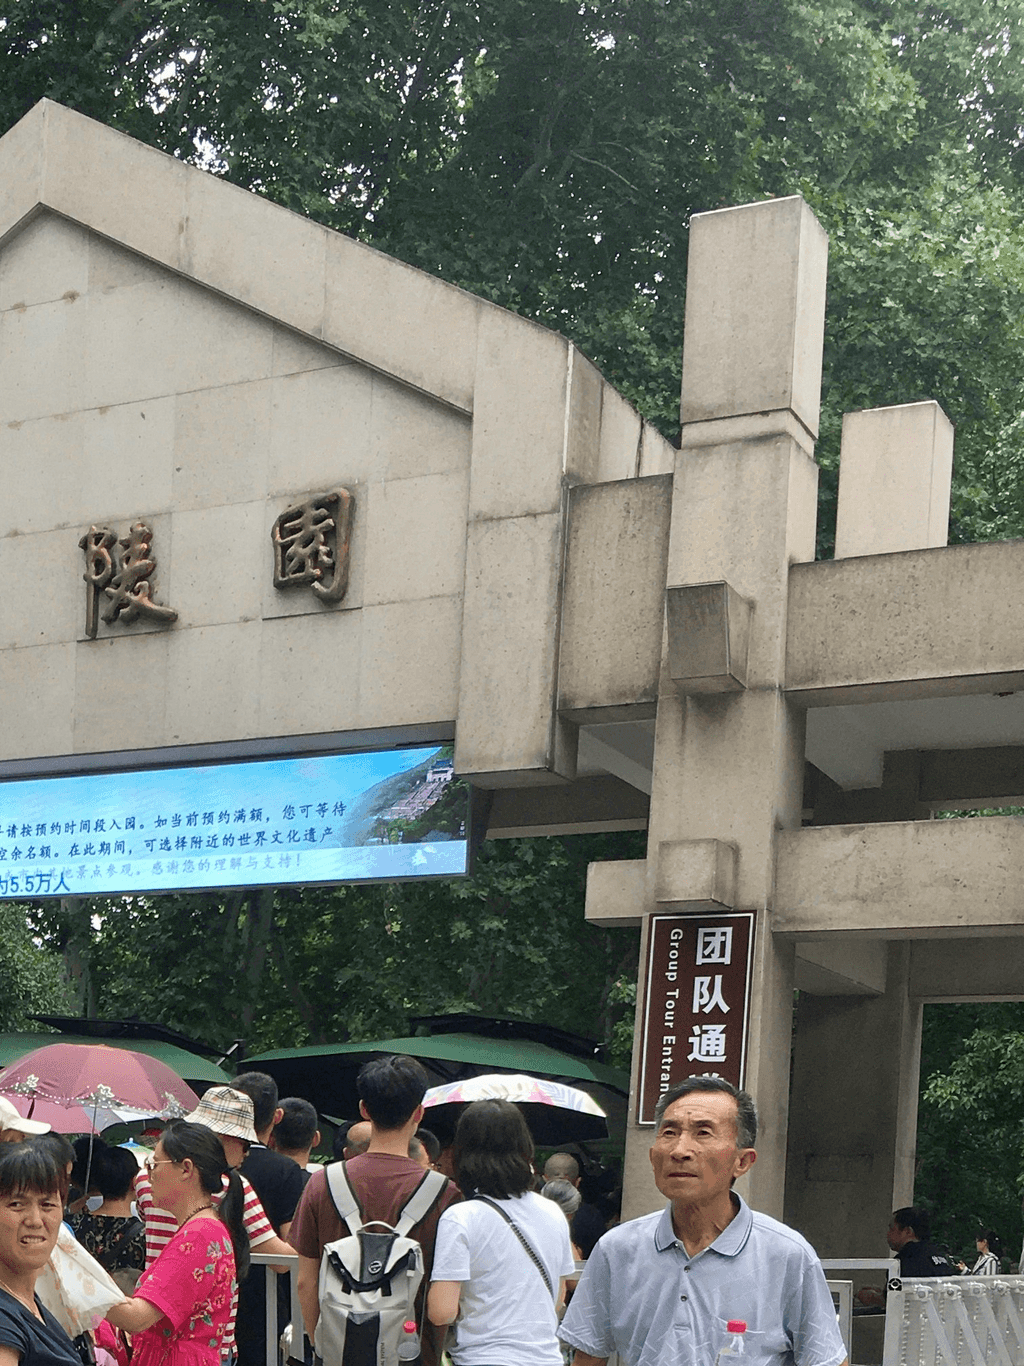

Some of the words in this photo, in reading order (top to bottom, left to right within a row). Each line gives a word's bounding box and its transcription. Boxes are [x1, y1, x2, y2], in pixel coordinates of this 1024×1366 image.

[665, 928, 683, 982] Group
[664, 988, 680, 1029] Tour
[687, 926, 733, 1081] 团队通
